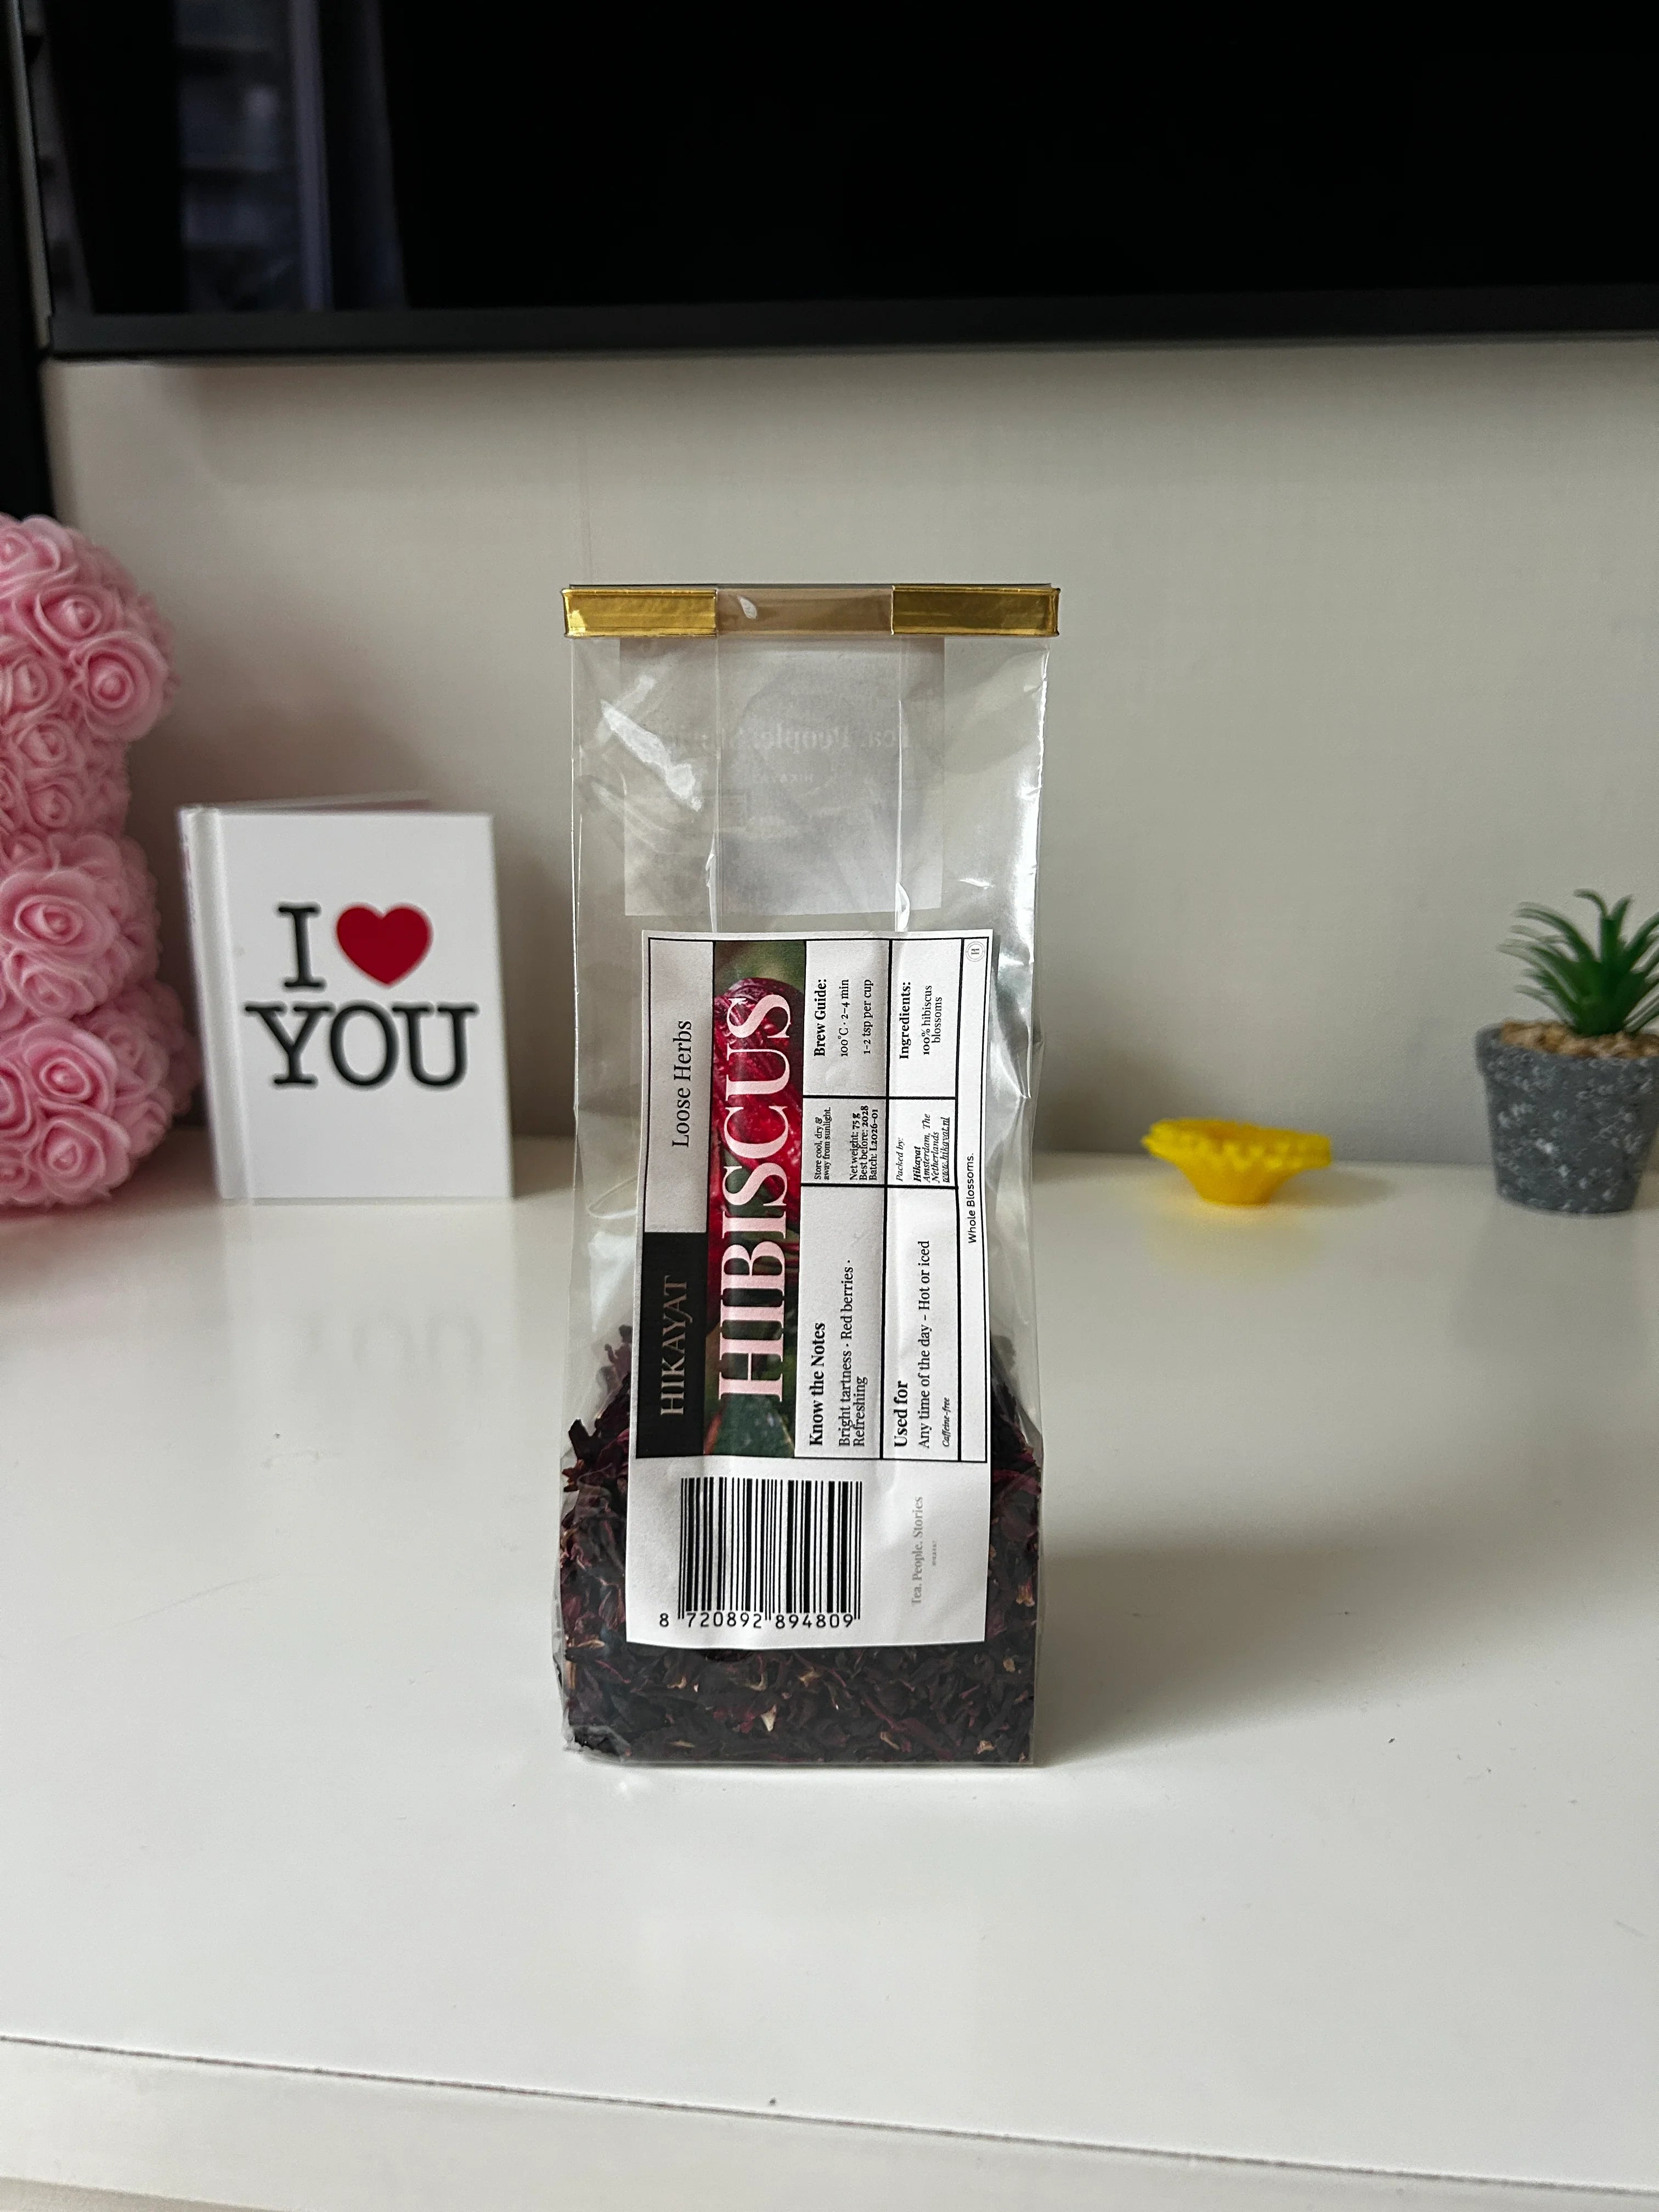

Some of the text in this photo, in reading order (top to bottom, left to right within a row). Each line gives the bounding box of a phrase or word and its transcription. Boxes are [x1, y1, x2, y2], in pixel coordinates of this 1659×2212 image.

[275, 902, 323, 989] I
[839, 979, 849, 999] min
[864, 980, 873, 998] cup
[814, 979, 827, 1057] Brew Guide:
[864, 1001, 873, 1018] per
[899, 981, 911, 1059] Ingredients:
[922, 985, 932, 1056] 100% hibiscus
[932, 997, 943, 1043] blossoms
[245, 1000, 479, 1088] YOU
[864, 1022, 873, 1036] tsp
[672, 1020, 692, 1148] Loose Herbs
[815, 1126, 824, 1139] dry
[822, 1107, 832, 1180] away from sunlight.
[853, 1120, 860, 1130] 75
[859, 1105, 869, 1181] Best before: 2028
[896, 1137, 905, 1149] by:
[814, 1140, 823, 1158] cool,
[850, 1132, 861, 1164] weight:
[868, 1153, 877, 1181] Batch:
[913, 1146, 922, 1182] Hikayat
[923, 1114, 931, 1183] Amsterdam, The
[931, 1132, 940, 1183] Netherlands
[940, 1117, 950, 1183] www.hikayat.nl
[814, 1160, 822, 1180] Store
[850, 1164, 859, 1181] Net
[719, 994, 792, 1402] HIBISCUS
[966, 1153, 976, 1244] Whole Blossoms.
[918, 1241, 930, 1266] iced
[841, 1267, 853, 1312] berries
[921, 1269, 930, 1284] or
[918, 1288, 930, 1310] Hot
[660, 1274, 693, 1415] HIKAYAT
[840, 1316, 852, 1339] Red
[918, 1324, 932, 1347] day
[840, 1351, 851, 1402] tartness
[918, 1351, 930, 1370] the
[918, 1372, 930, 1386] of
[809, 1323, 825, 1446] Know the Notes
[852, 1376, 867, 1447] Refreshing
[893, 1380, 908, 1447] Used for
[918, 1390, 930, 1419] time
[941, 1397, 951, 1447] Caffeine-free
[838, 1406, 853, 1446] Bright
[918, 1423, 932, 1448] Any
[912, 1497, 923, 1538] Stories
[659, 1611, 854, 1629] 8 720892 894809
